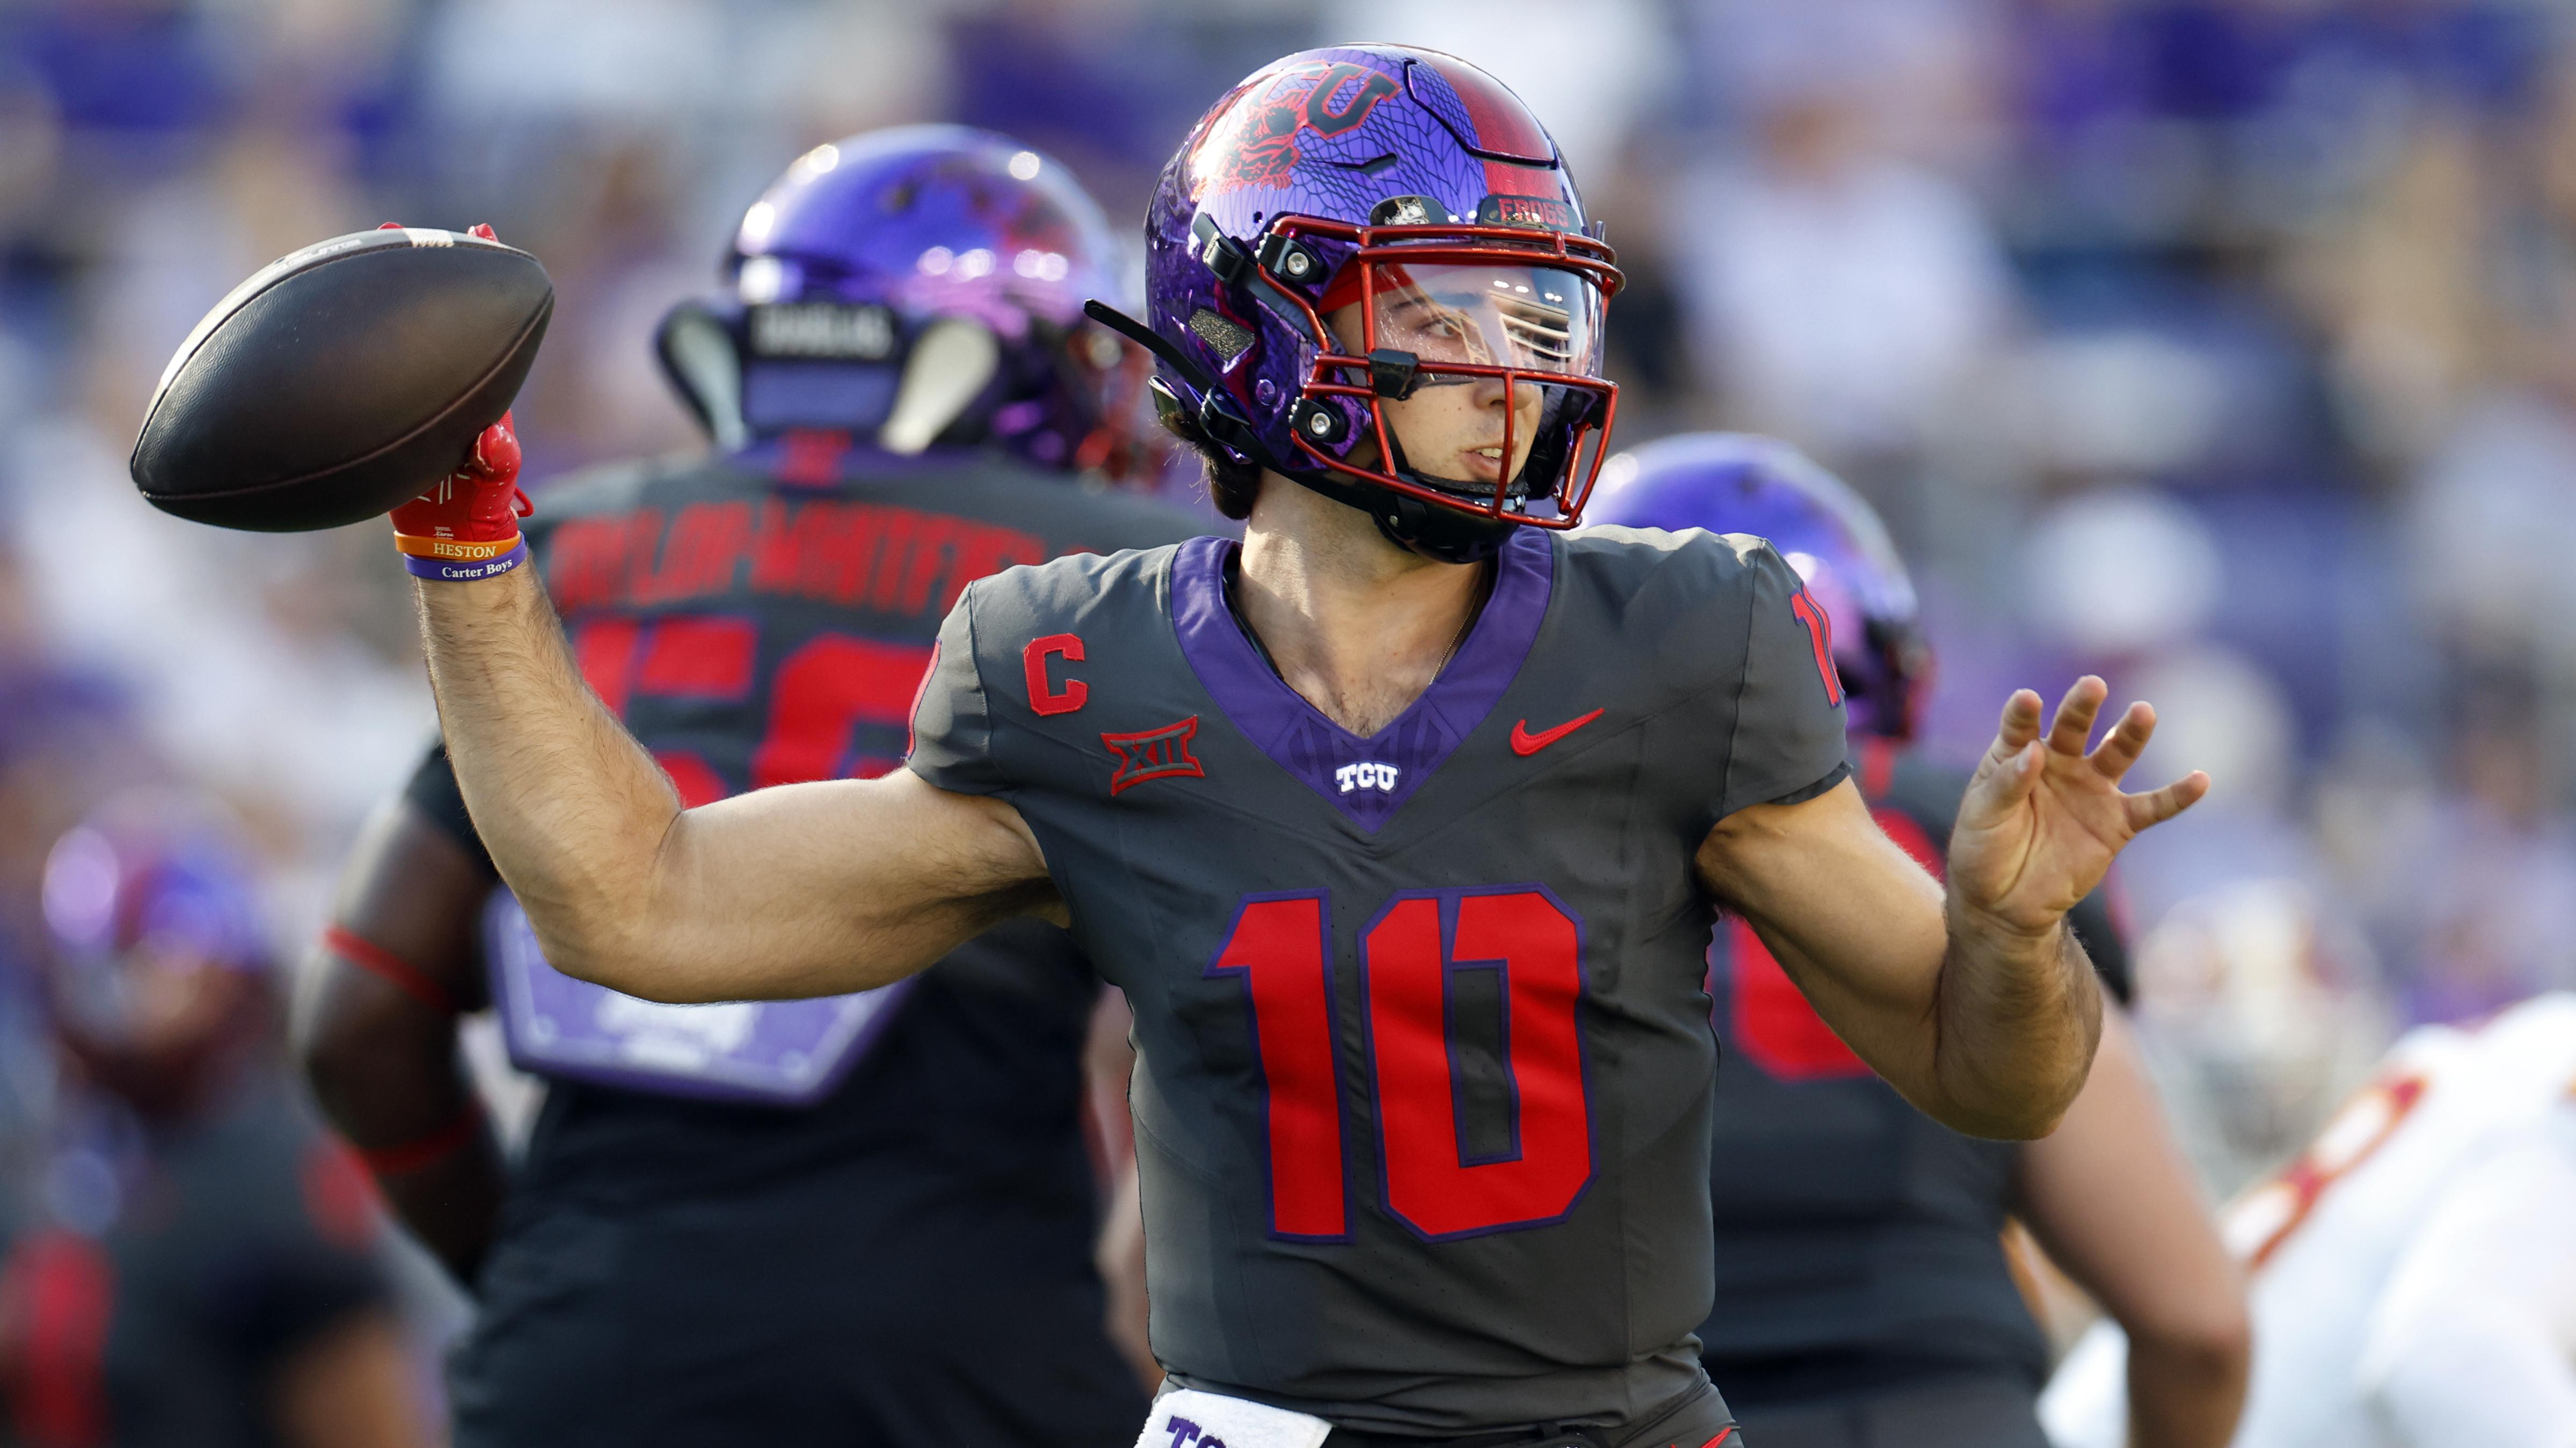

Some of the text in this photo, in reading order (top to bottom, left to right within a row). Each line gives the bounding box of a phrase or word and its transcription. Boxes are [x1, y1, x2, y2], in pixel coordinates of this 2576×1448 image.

[1498, 198, 1570, 228] FROGS
[433, 542, 497, 558] HESTON
[442, 559, 513, 578] Carter Boys
[1789, 580, 1846, 710] 1
[1023, 632, 1089, 716] C
[1106, 720, 1200, 790] XII
[1336, 762, 1398, 793] TCU
[1203, 882, 1599, 1245] 10
